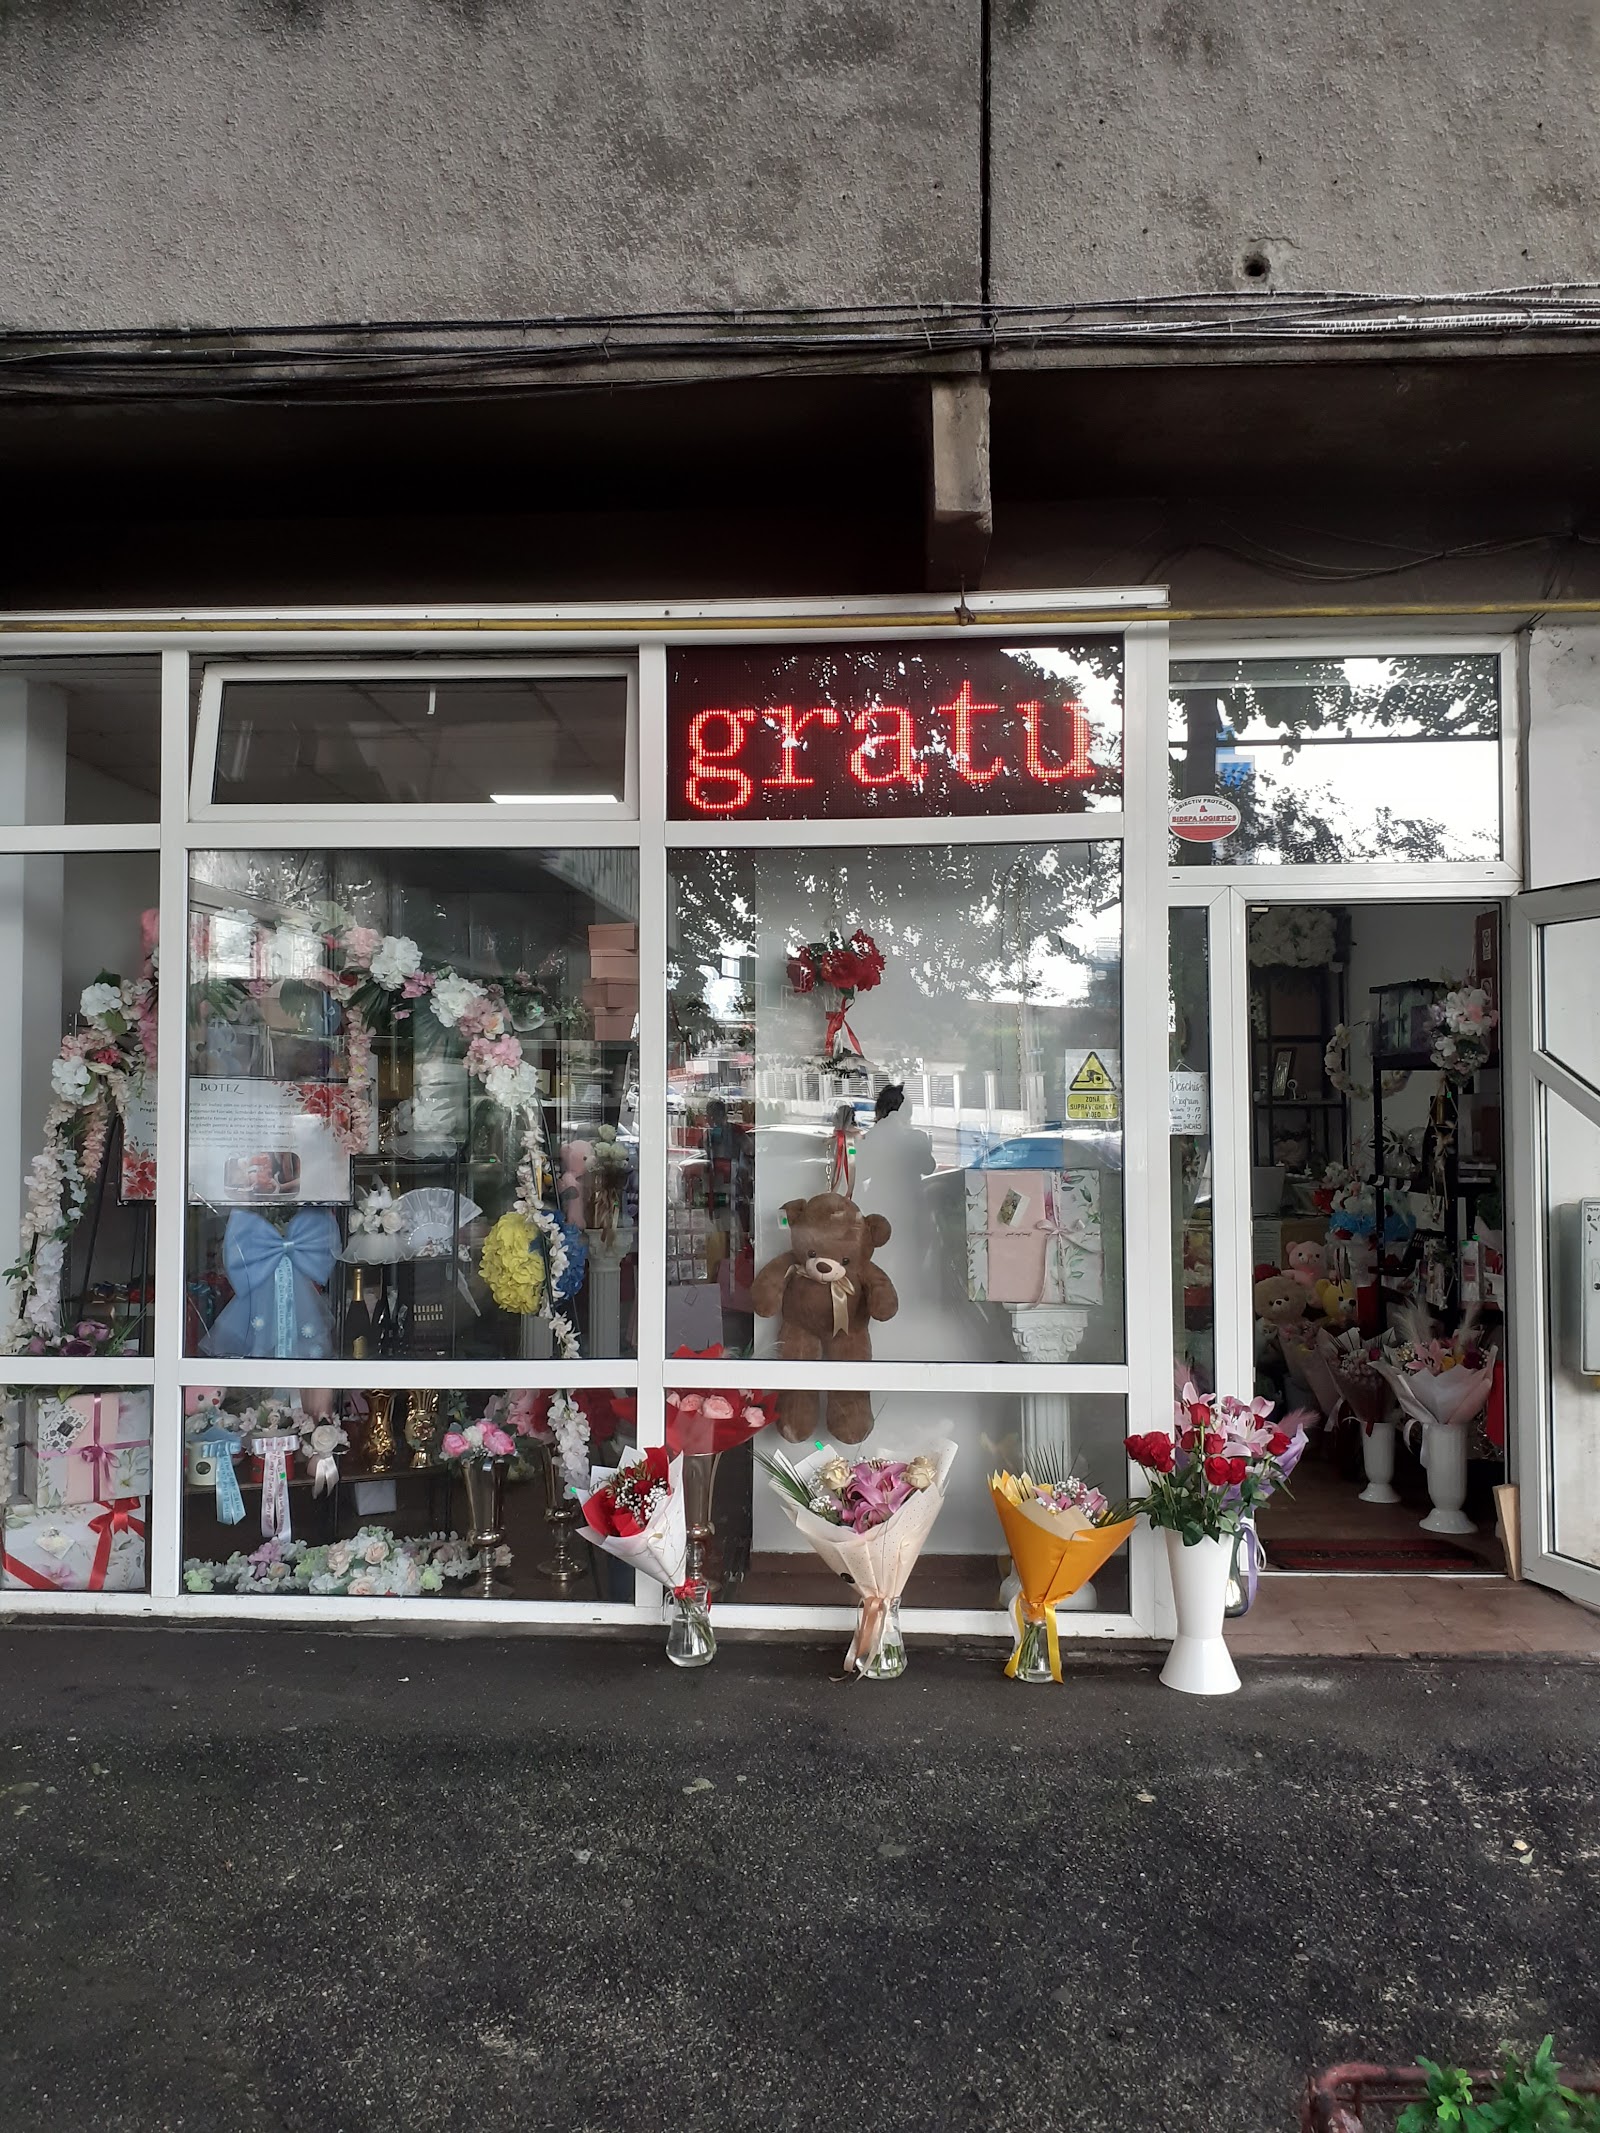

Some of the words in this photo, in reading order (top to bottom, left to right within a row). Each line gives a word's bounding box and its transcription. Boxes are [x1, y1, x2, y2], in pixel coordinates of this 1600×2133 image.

[685, 680, 1098, 810] gratu
[1175, 799, 1202, 812] OBIECTIV
[1203, 799, 1232, 811] PROTEJAT
[200, 1083, 244, 1095] BOTEZ
[1170, 1078, 1203, 1093] Deschis
